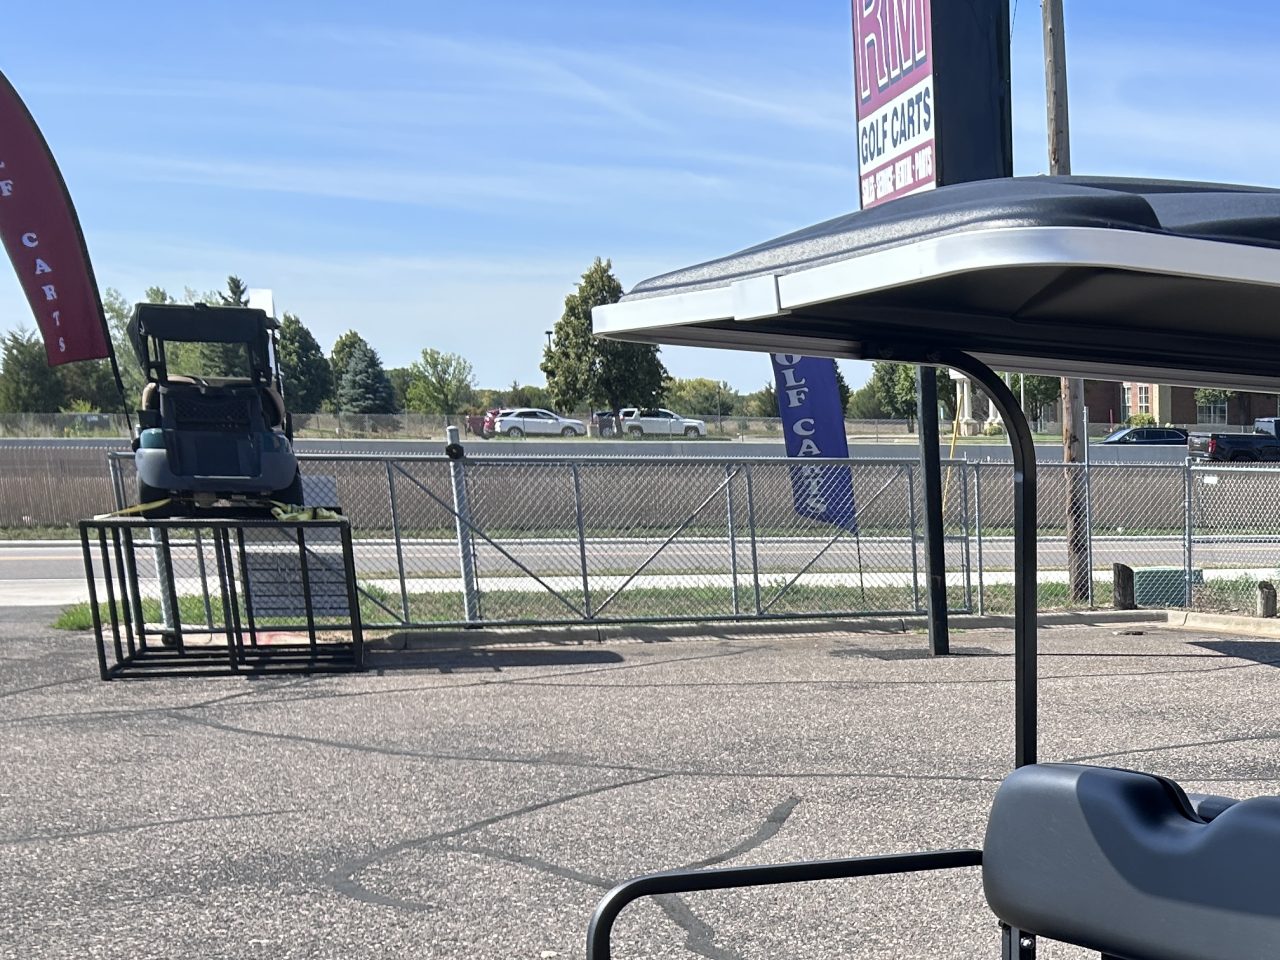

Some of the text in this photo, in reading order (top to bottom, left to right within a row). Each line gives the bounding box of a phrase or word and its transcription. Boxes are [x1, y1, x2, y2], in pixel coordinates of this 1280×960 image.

[861, 86, 931, 166] GOLF CARTS
[21, 231, 67, 353] CARTS
